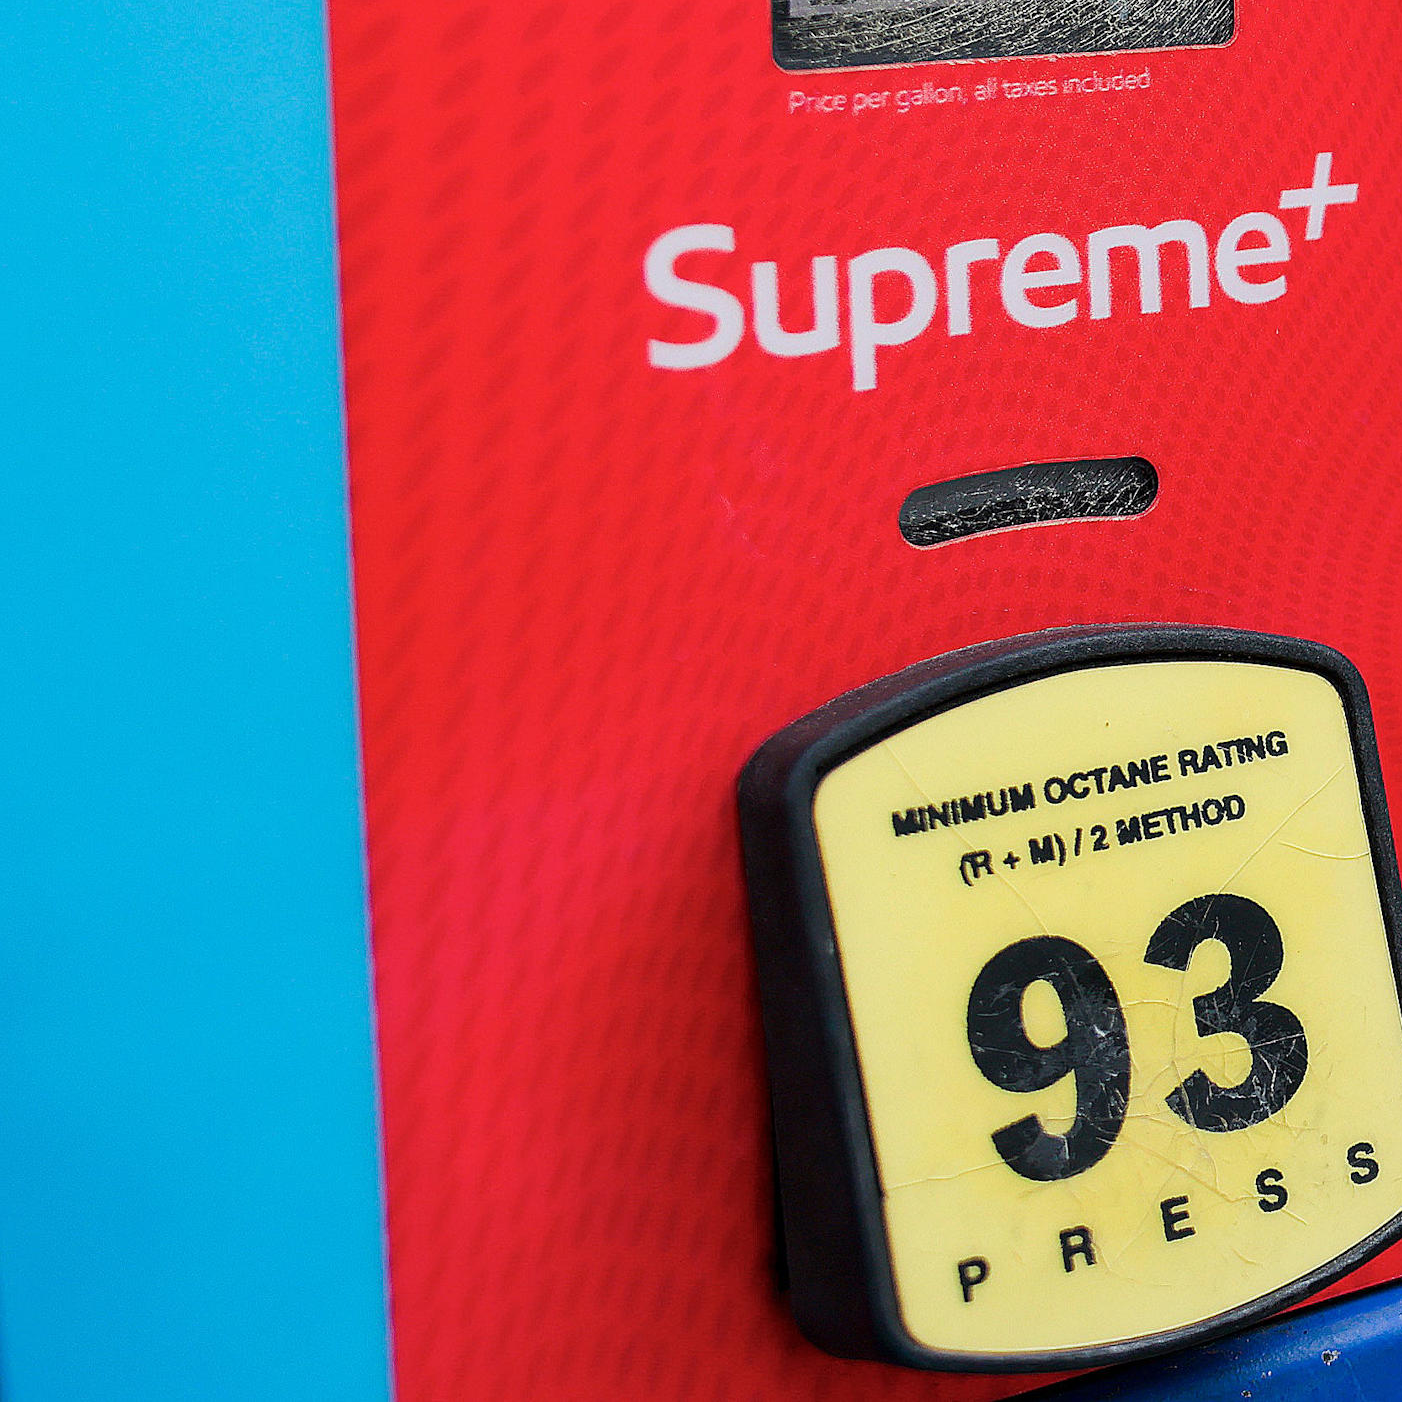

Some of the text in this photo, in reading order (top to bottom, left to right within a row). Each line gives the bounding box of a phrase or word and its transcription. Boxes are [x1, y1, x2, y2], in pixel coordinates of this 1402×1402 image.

[789, 67, 1151, 115] Price per gallon, all taxes included
[892, 730, 1290, 838] MINIMUM OCTANE RATING
[958, 793, 1247, 887] (R + M) / 2 METHOD
[966, 892, 1309, 1182] 93
[957, 1142, 1381, 1303] PRESS
